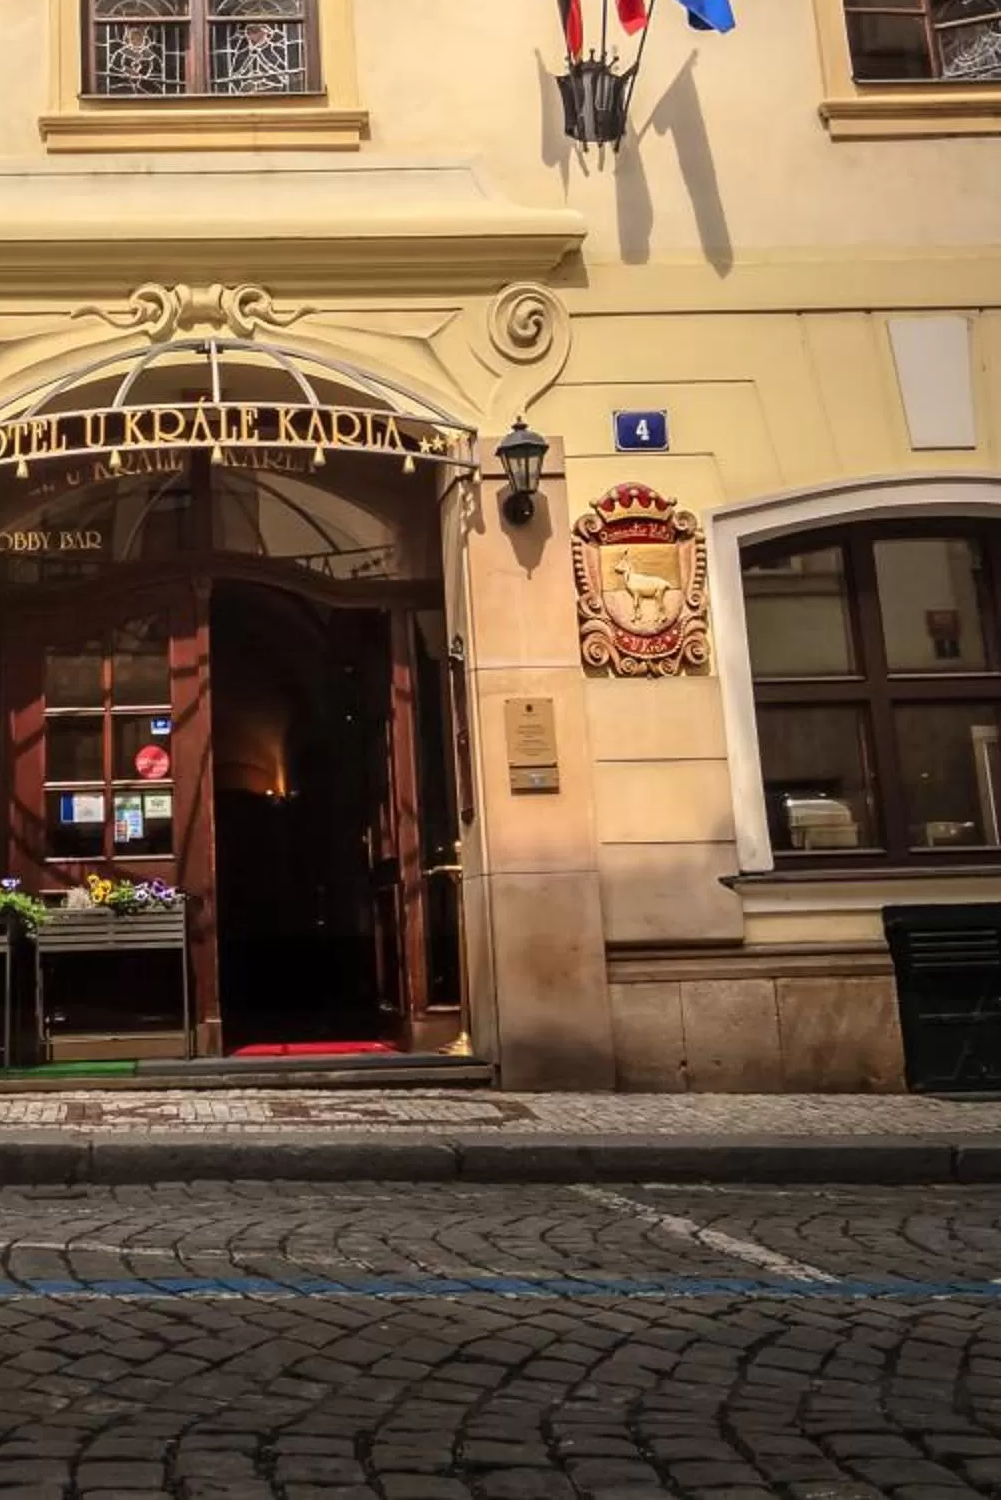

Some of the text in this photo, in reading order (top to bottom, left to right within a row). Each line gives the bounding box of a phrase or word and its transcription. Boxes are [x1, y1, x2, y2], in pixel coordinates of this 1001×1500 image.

[84, 412, 108, 448] U
[123, 396, 259, 444] KRÁLE
[276, 406, 407, 452] KARLA
[636, 419, 649, 441] 4
[59, 530, 102, 550] BAR
